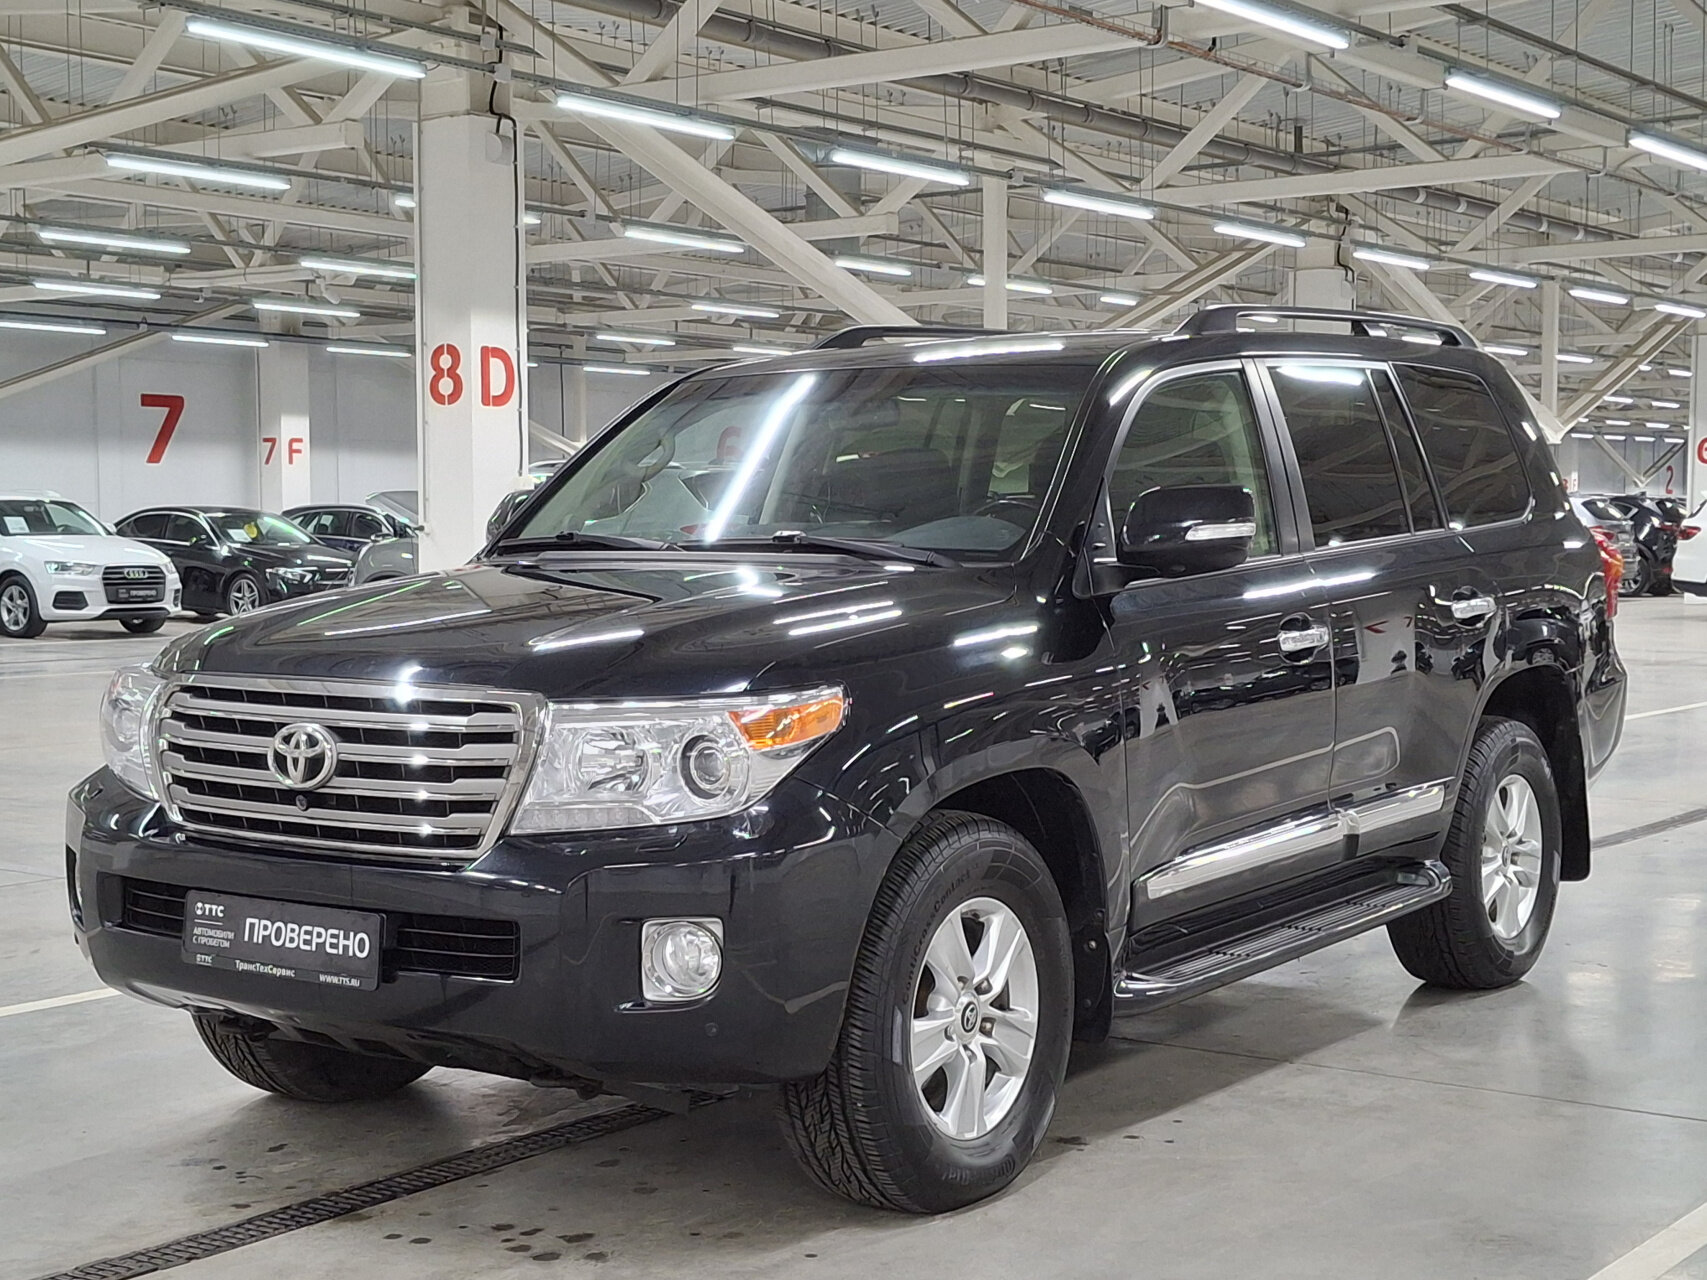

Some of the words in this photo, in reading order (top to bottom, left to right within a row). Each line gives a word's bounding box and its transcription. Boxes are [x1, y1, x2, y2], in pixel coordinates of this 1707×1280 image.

[430, 343, 464, 406] 8
[480, 346, 516, 407] D
[140, 393, 185, 463] 7
[262, 437, 277, 465] 7
[288, 437, 304, 465] F
[1665, 465, 1674, 494] 2
[203, 903, 225, 918] ТТС
[244, 917, 371, 960] ПРОВЕРЕНО
